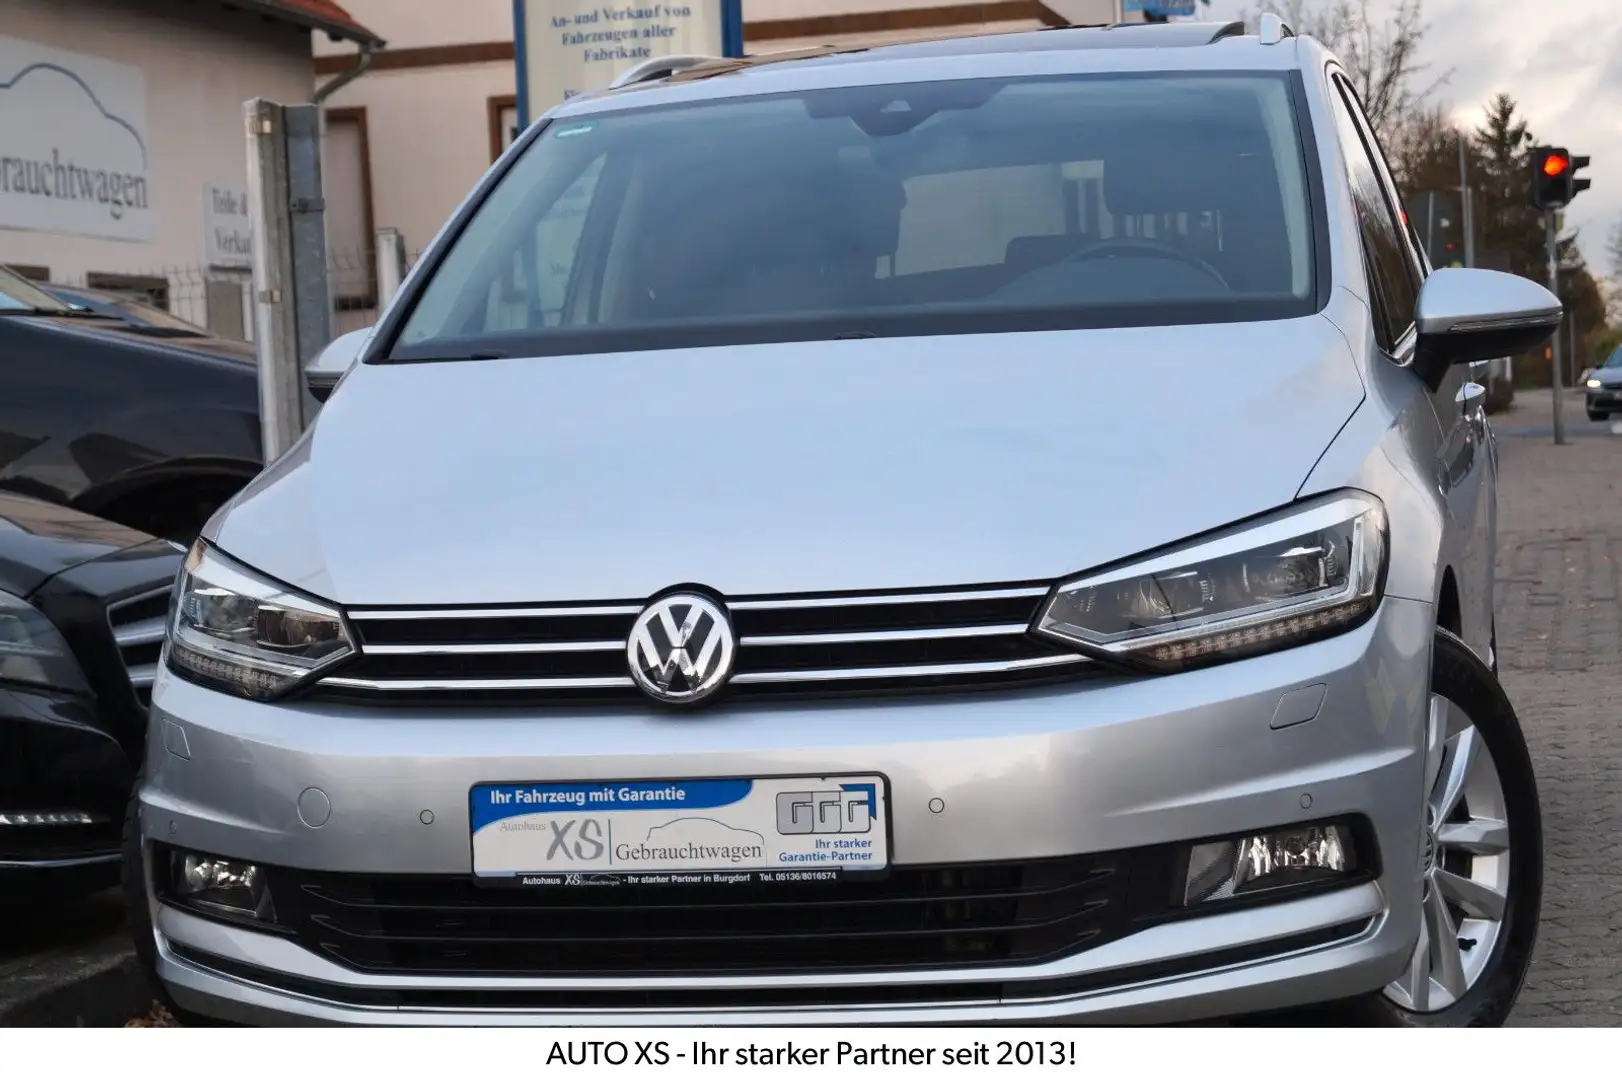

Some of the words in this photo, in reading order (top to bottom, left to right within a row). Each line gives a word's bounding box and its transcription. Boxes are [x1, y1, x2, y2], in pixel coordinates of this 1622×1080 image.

[551, 16, 571, 27] An-
[575, 11, 598, 24] und
[602, 6, 659, 21] Verkauf
[664, 6, 691, 17] von
[562, 28, 638, 45] Fahrzeugen
[643, 24, 676, 38] aller
[584, 47, 651, 62] Fabrikate
[0, 147, 149, 220] rauchtwagen
[491, 790, 512, 804] Ihr
[515, 788, 585, 806] Fahrzeug
[589, 788, 614, 801] mit
[618, 786, 686, 801] Garantie
[500, 821, 546, 832] Autohaus
[546, 819, 604, 861] XS
[815, 838, 831, 849] Ihr
[833, 838, 872, 849] starker
[616, 841, 762, 862] Gebrauchtwagen
[779, 851, 872, 864] Garantie-Partner
[522, 877, 561, 885] Autohaus
[564, 873, 581, 886] XS
[628, 876, 638, 884] Ihr
[641, 875, 669, 884] starker
[671, 874, 701, 883] Partner
[703, 874, 712, 883] in
[713, 873, 750, 885] Burgdorf
[759, 873, 774, 881] Tel.
